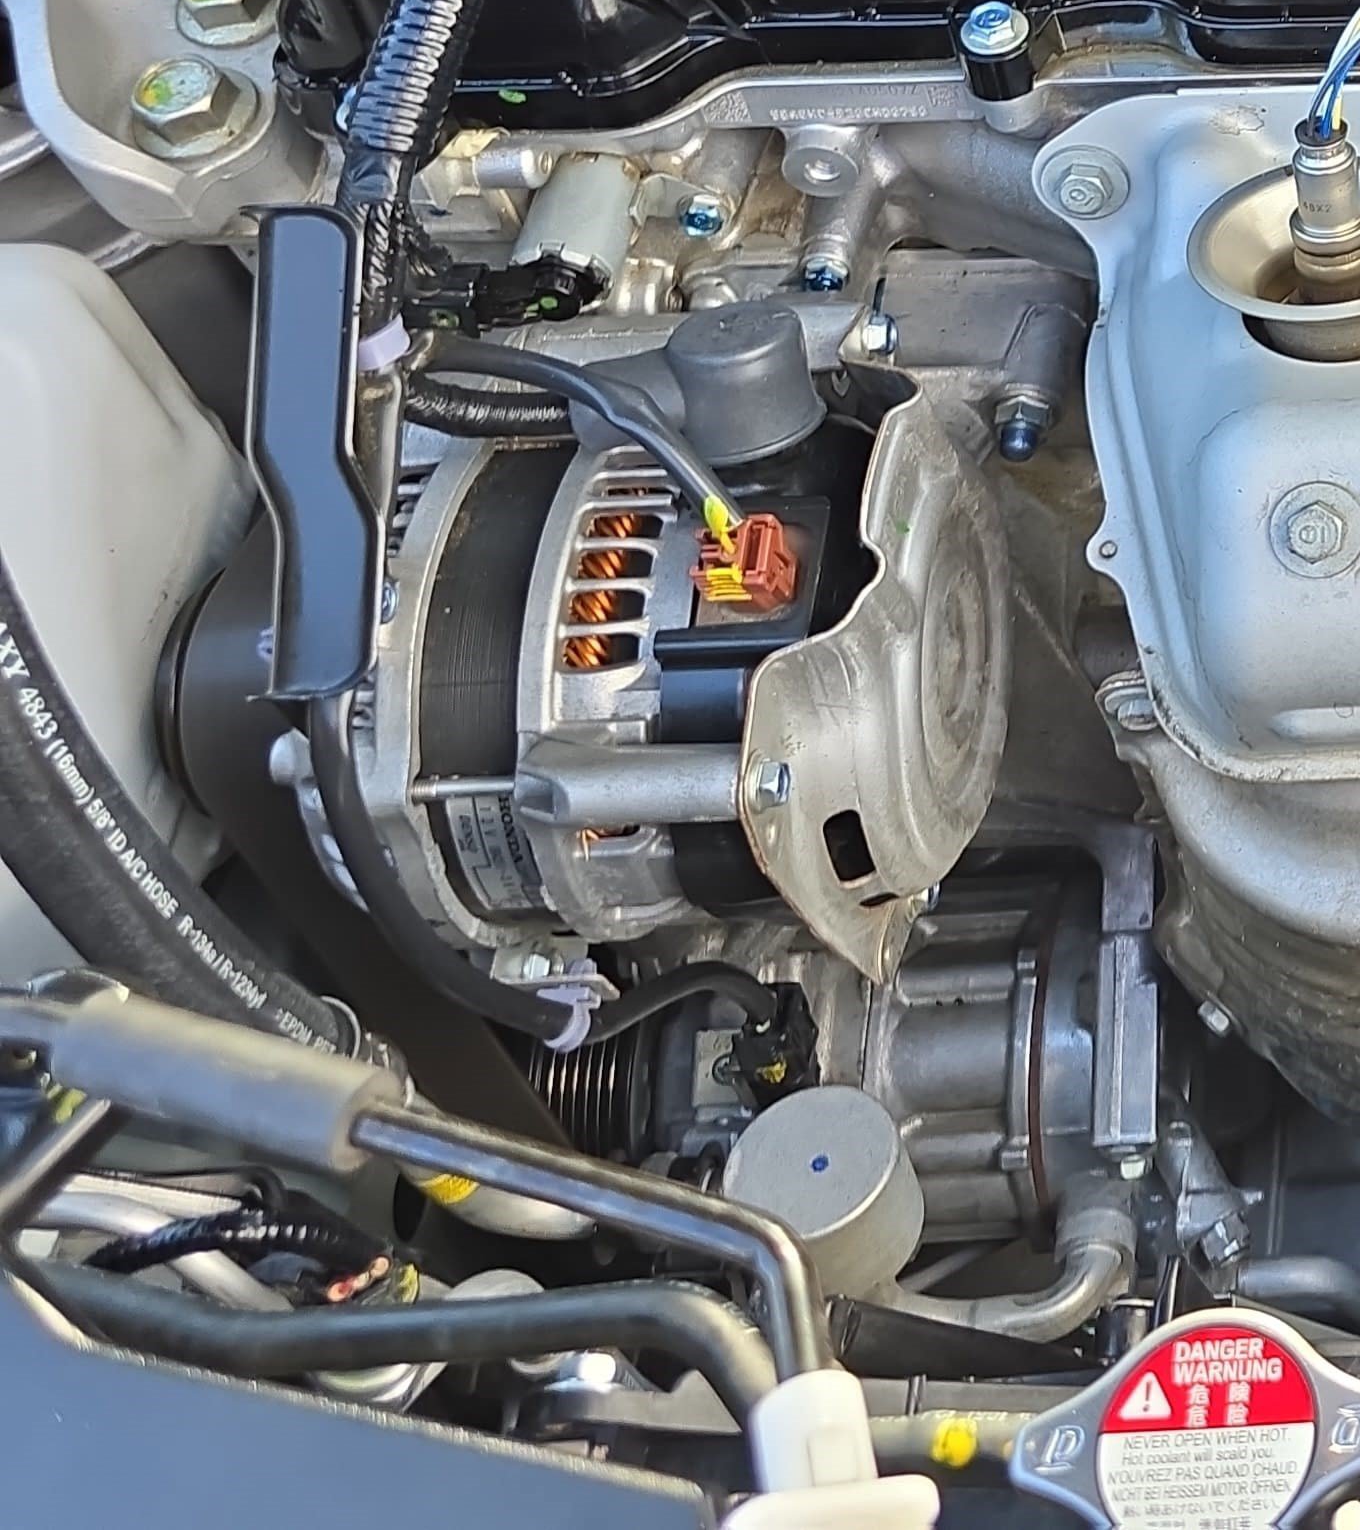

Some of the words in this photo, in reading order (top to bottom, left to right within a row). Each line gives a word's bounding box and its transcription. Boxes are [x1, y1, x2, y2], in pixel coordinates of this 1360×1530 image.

[17, 687, 59, 739] 4843
[45, 737, 95, 807] (16mm)
[105, 821, 129, 855] ID
[122, 844, 148, 883] A/C
[140, 871, 178, 919] HOSE
[1174, 1338, 1264, 1361] DANGER
[1173, 1359, 1283, 1384] WARNUNG
[1124, 1434, 1169, 1450] NEVER
[1175, 1433, 1210, 1447] OPEN
[1216, 1431, 1256, 1446] WHEN
[1260, 1428, 1290, 1442] HOT.
[1122, 1453, 1142, 1466] Hot
[1147, 1451, 1191, 1463] coolant
[1195, 1450, 1213, 1462] will
[1216, 1446, 1248, 1461] scald
[1175, 1467, 1200, 1481] PAS
[1205, 1464, 1249, 1480] QUAND
[1212, 1481, 1248, 1497] MOTOR
